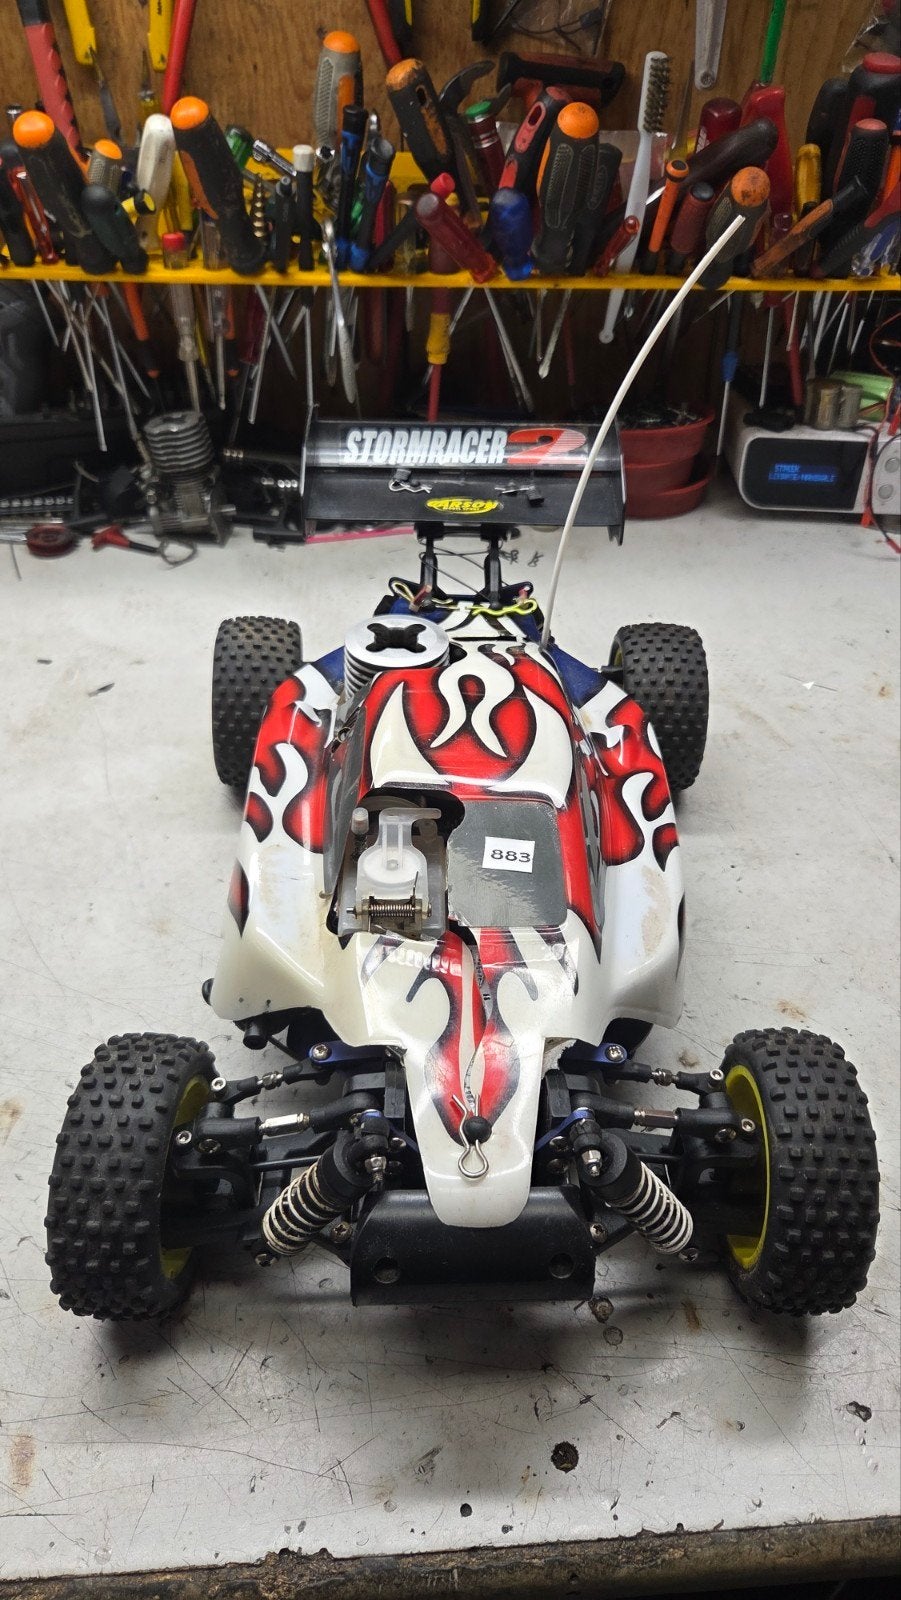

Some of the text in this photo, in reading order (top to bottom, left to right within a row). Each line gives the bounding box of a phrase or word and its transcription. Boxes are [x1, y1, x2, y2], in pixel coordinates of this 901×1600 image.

[344, 427, 587, 465] STORMRACER 2
[490, 849, 531, 863] 883
